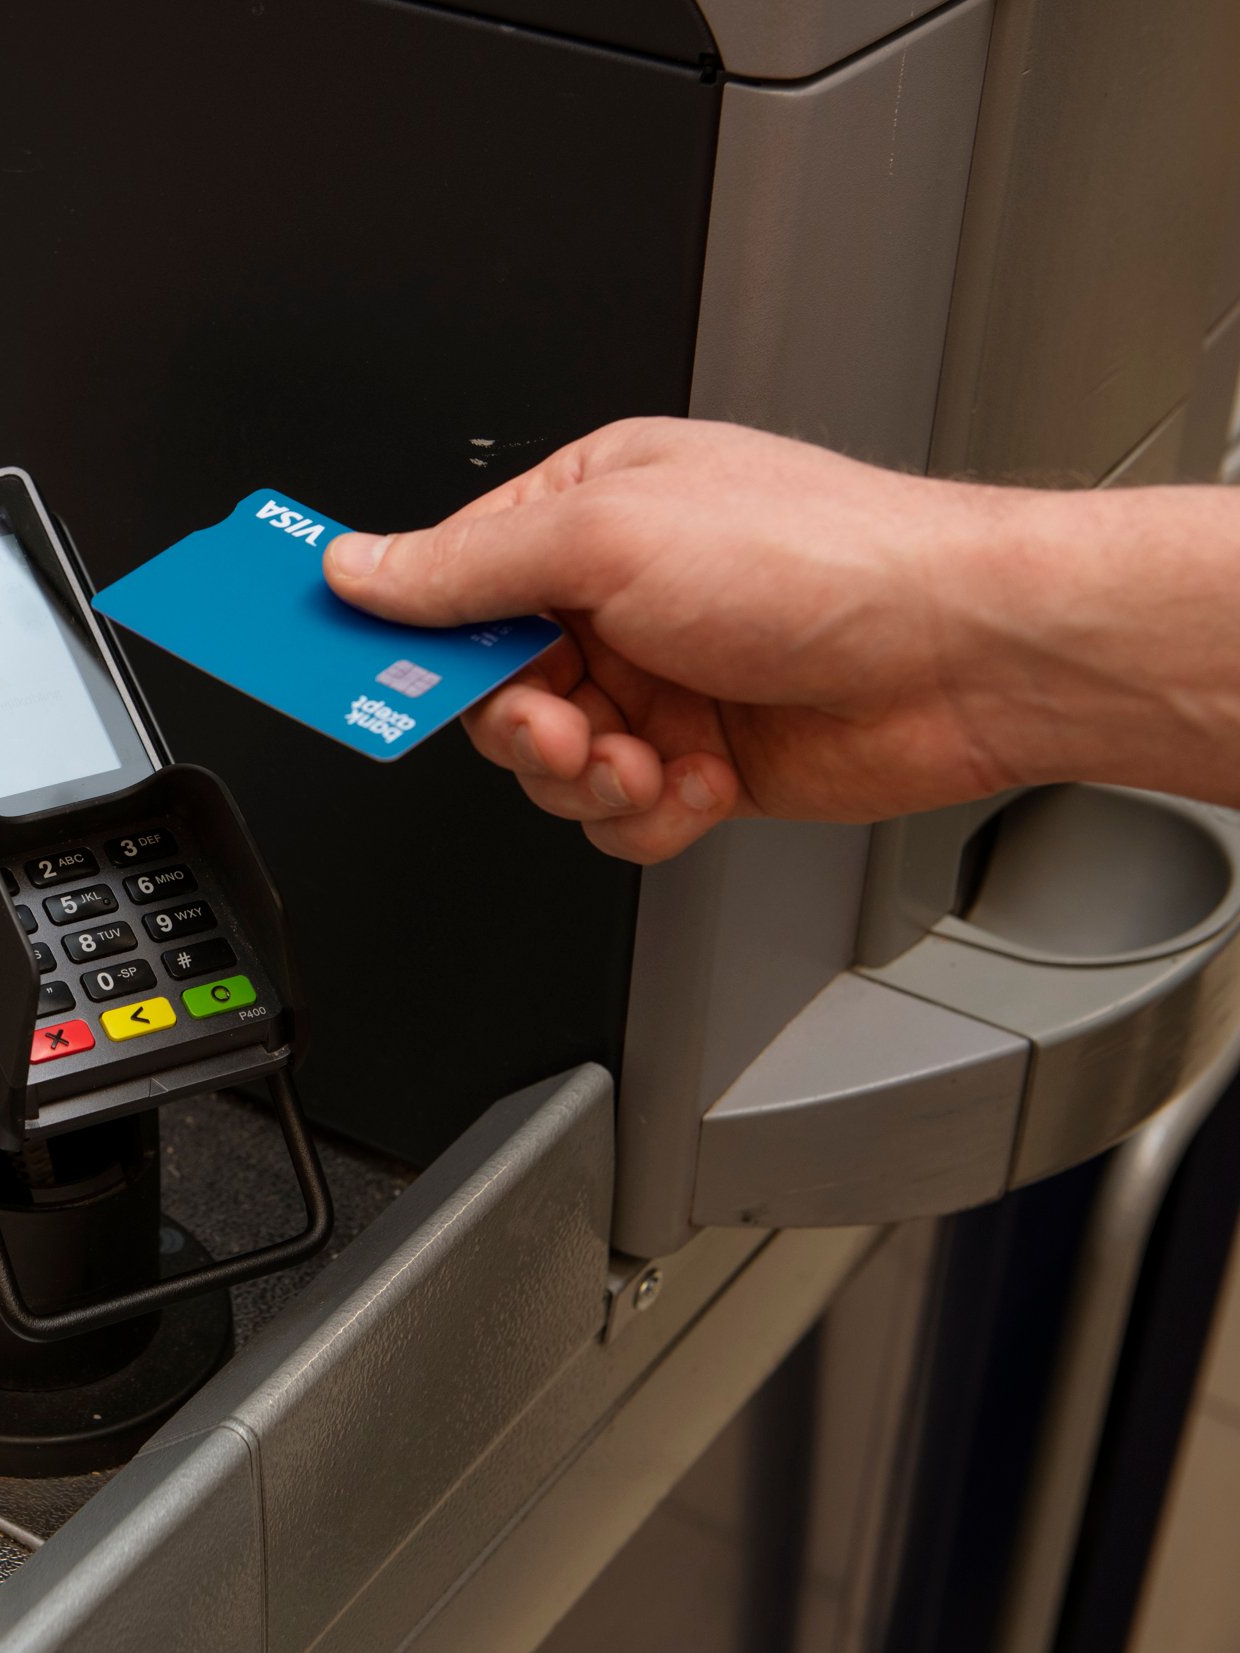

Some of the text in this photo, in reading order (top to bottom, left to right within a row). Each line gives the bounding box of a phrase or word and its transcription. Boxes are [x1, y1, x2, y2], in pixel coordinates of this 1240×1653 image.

[256, 500, 325, 547] VISA
[351, 695, 416, 731] axept
[344, 709, 405, 744] bank
[120, 834, 161, 857] 3 DEF
[38, 853, 85, 879] 2 ABC
[137, 870, 185, 894] 6 MNO
[60, 891, 102, 914] 5 JKL
[156, 907, 203, 933] 9 WXY
[78, 928, 122, 952] 8 TUV
[176, 951, 192, 969] #
[96, 972, 115, 991] 0
[238, 1006, 267, 1021] P400
